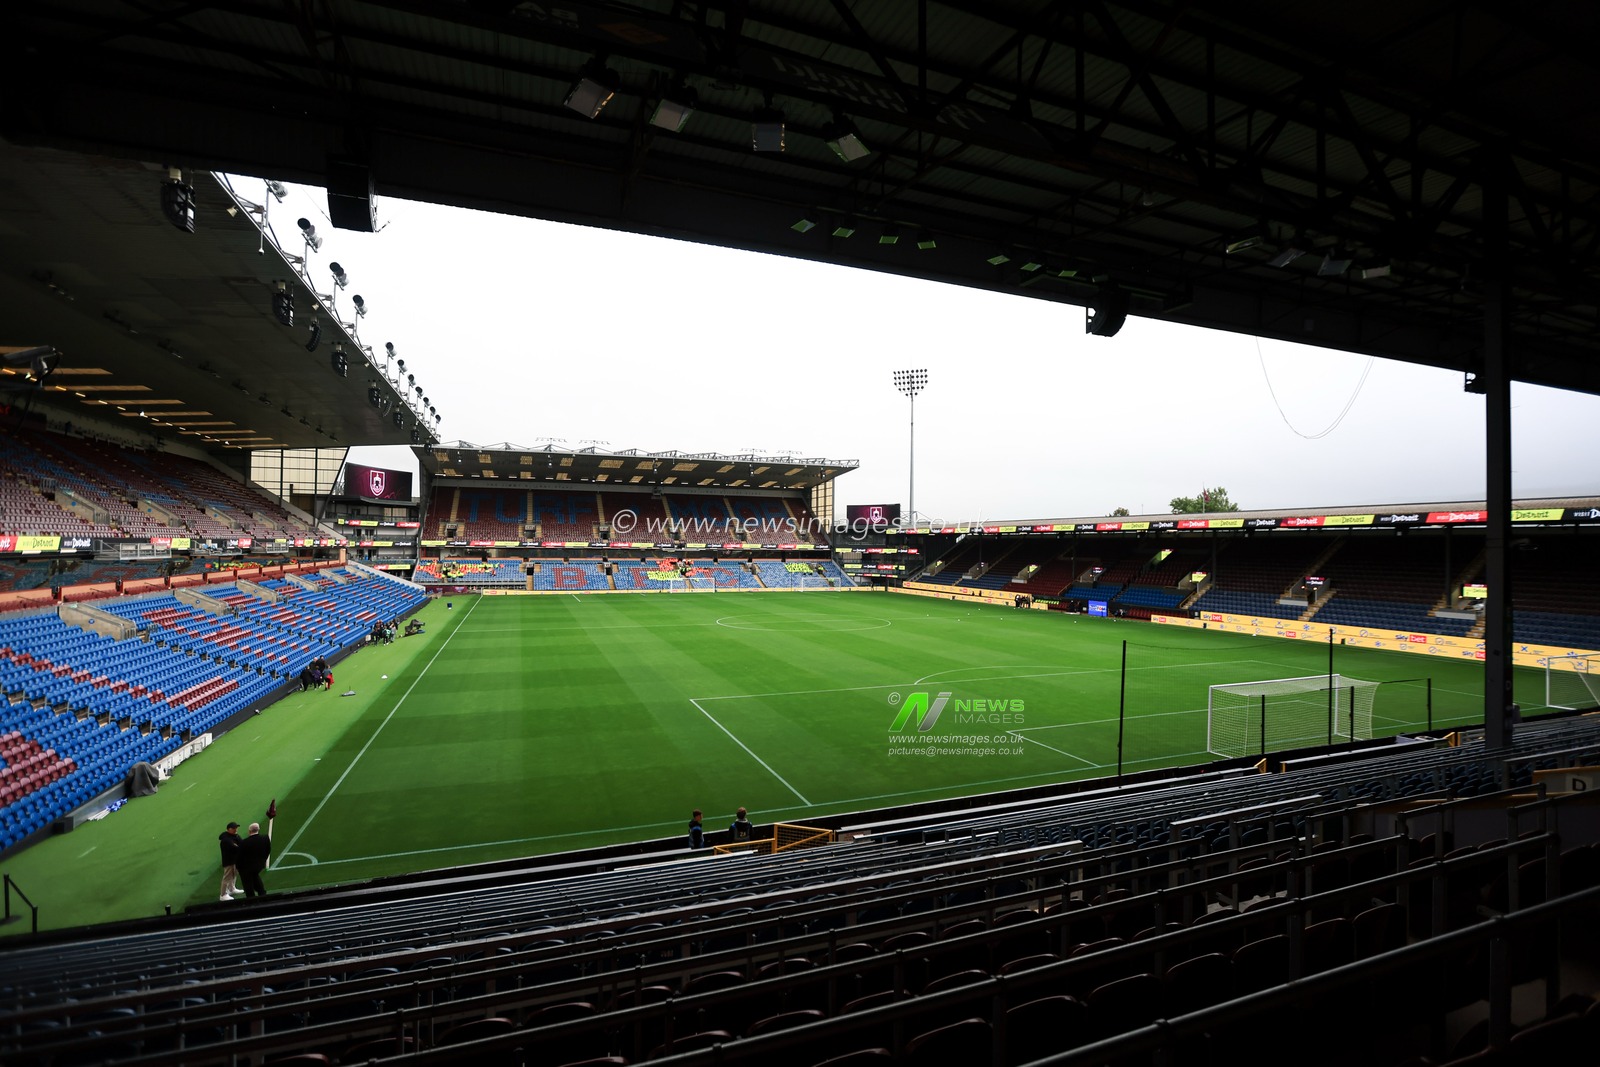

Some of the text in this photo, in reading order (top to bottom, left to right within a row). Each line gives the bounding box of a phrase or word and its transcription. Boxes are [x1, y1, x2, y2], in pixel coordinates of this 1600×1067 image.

[1391, 514, 1419, 523] Detroit
[1449, 512, 1480, 521] Detroit
[1515, 511, 1549, 519] Detroit
[1410, 635, 1426, 643] bet
[1572, 778, 1587, 791] D
